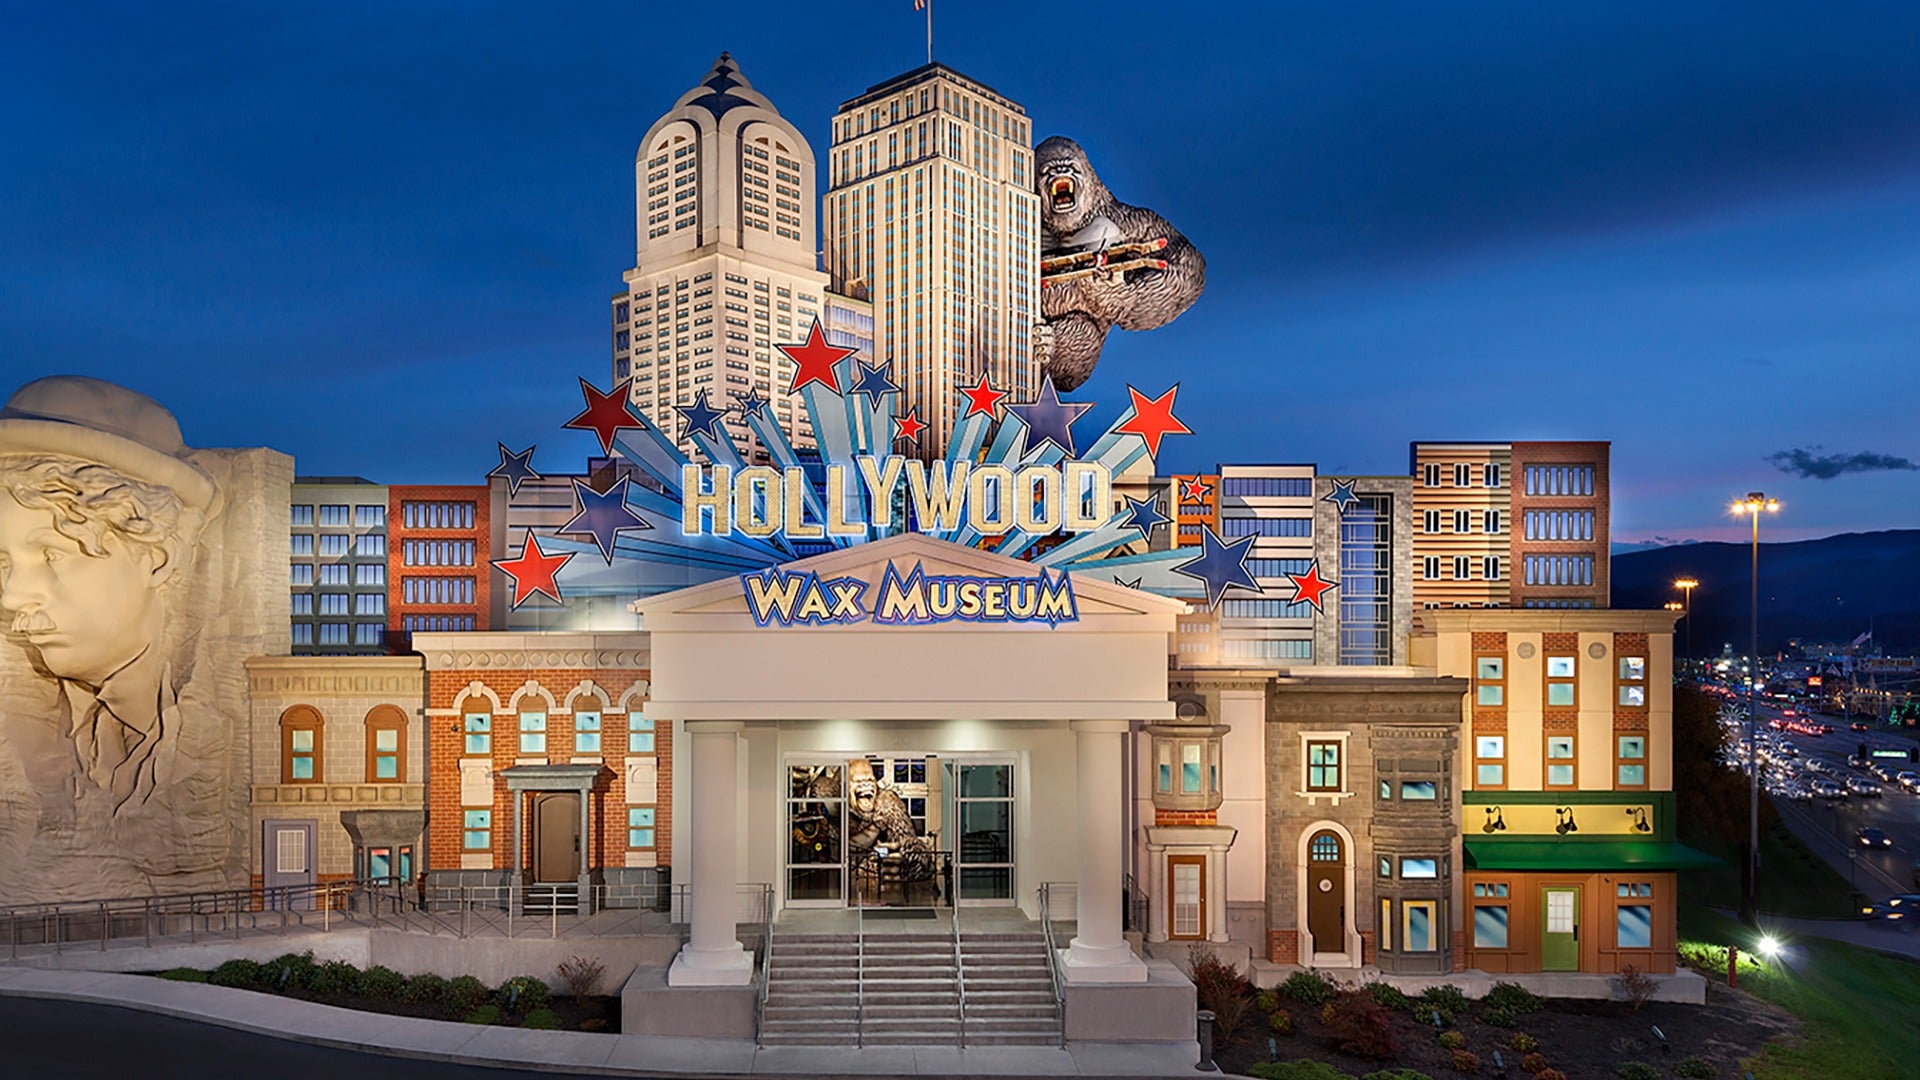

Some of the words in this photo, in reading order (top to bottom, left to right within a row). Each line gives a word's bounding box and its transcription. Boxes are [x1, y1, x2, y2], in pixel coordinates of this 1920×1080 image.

[684, 456, 1111, 538] HOLLYWOOD
[745, 570, 865, 624] WAX
[877, 570, 1076, 624] MUSEUM
